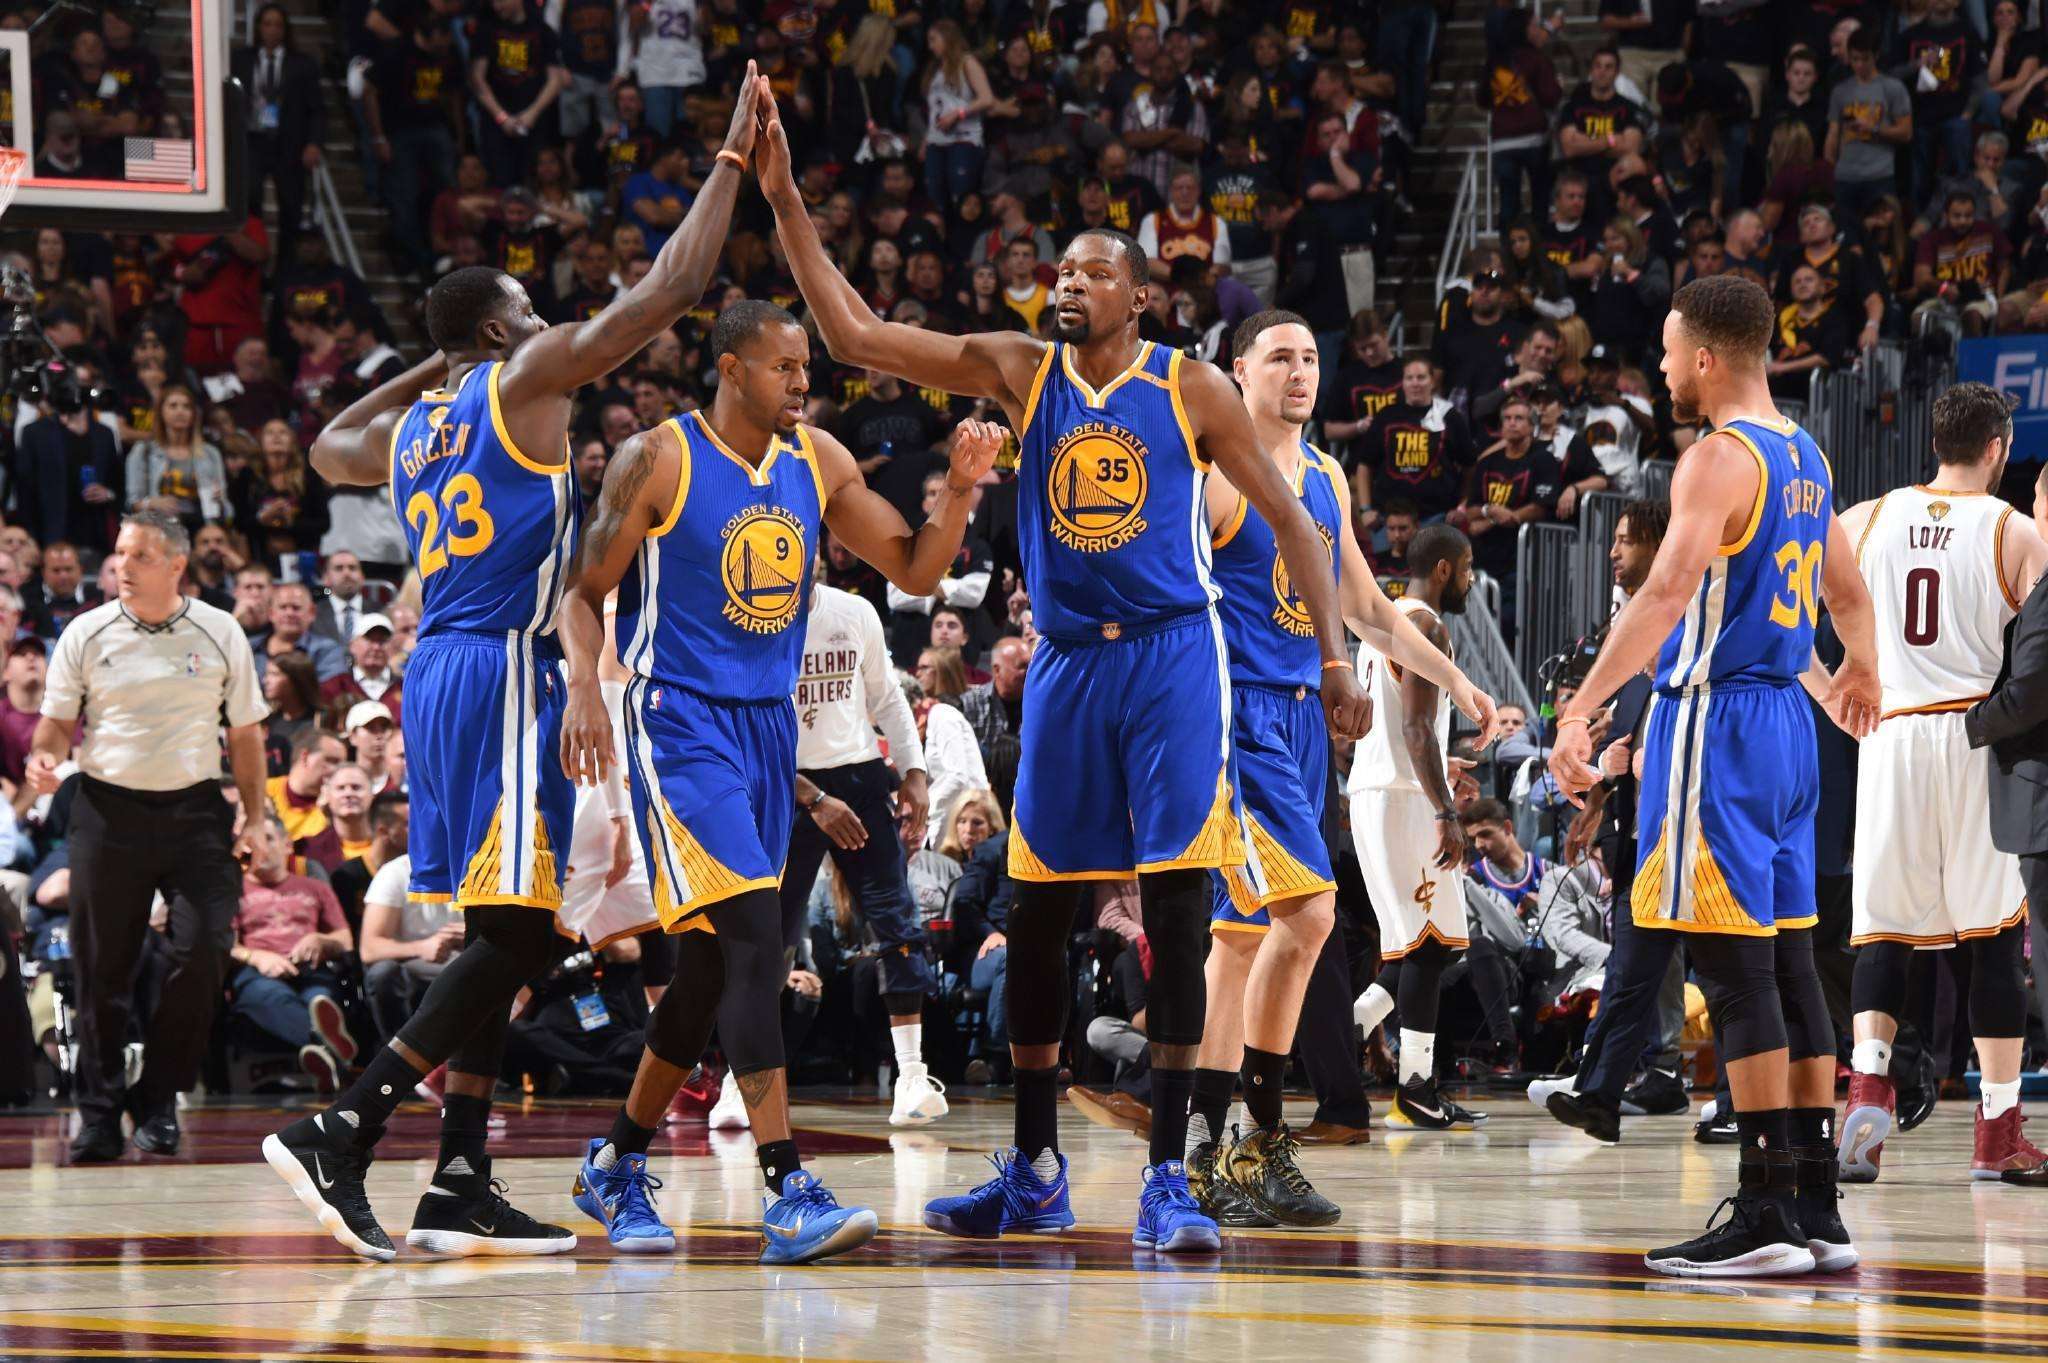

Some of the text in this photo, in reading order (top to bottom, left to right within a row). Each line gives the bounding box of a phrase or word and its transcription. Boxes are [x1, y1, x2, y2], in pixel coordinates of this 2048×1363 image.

[658, 10, 690, 40] 23
[400, 422, 472, 480] GREEN
[1051, 422, 1104, 457] GOLDEN
[1110, 424, 1150, 457] STATE
[1396, 432, 1429, 450] THE
[1096, 458, 1129, 482] 35
[1396, 450, 1429, 467] LAND
[405, 472, 495, 581] 23
[720, 504, 806, 539] GOLDEN STATE
[1049, 516, 1149, 554] WARRIORS
[775, 537, 790, 560] 9
[1909, 525, 1955, 551] LOVE
[1769, 540, 1823, 630] 30
[1272, 605, 1315, 637] WARR
[1904, 567, 1941, 646] 0
[805, 650, 857, 675] ELAND
[798, 680, 853, 705] ALIERS
